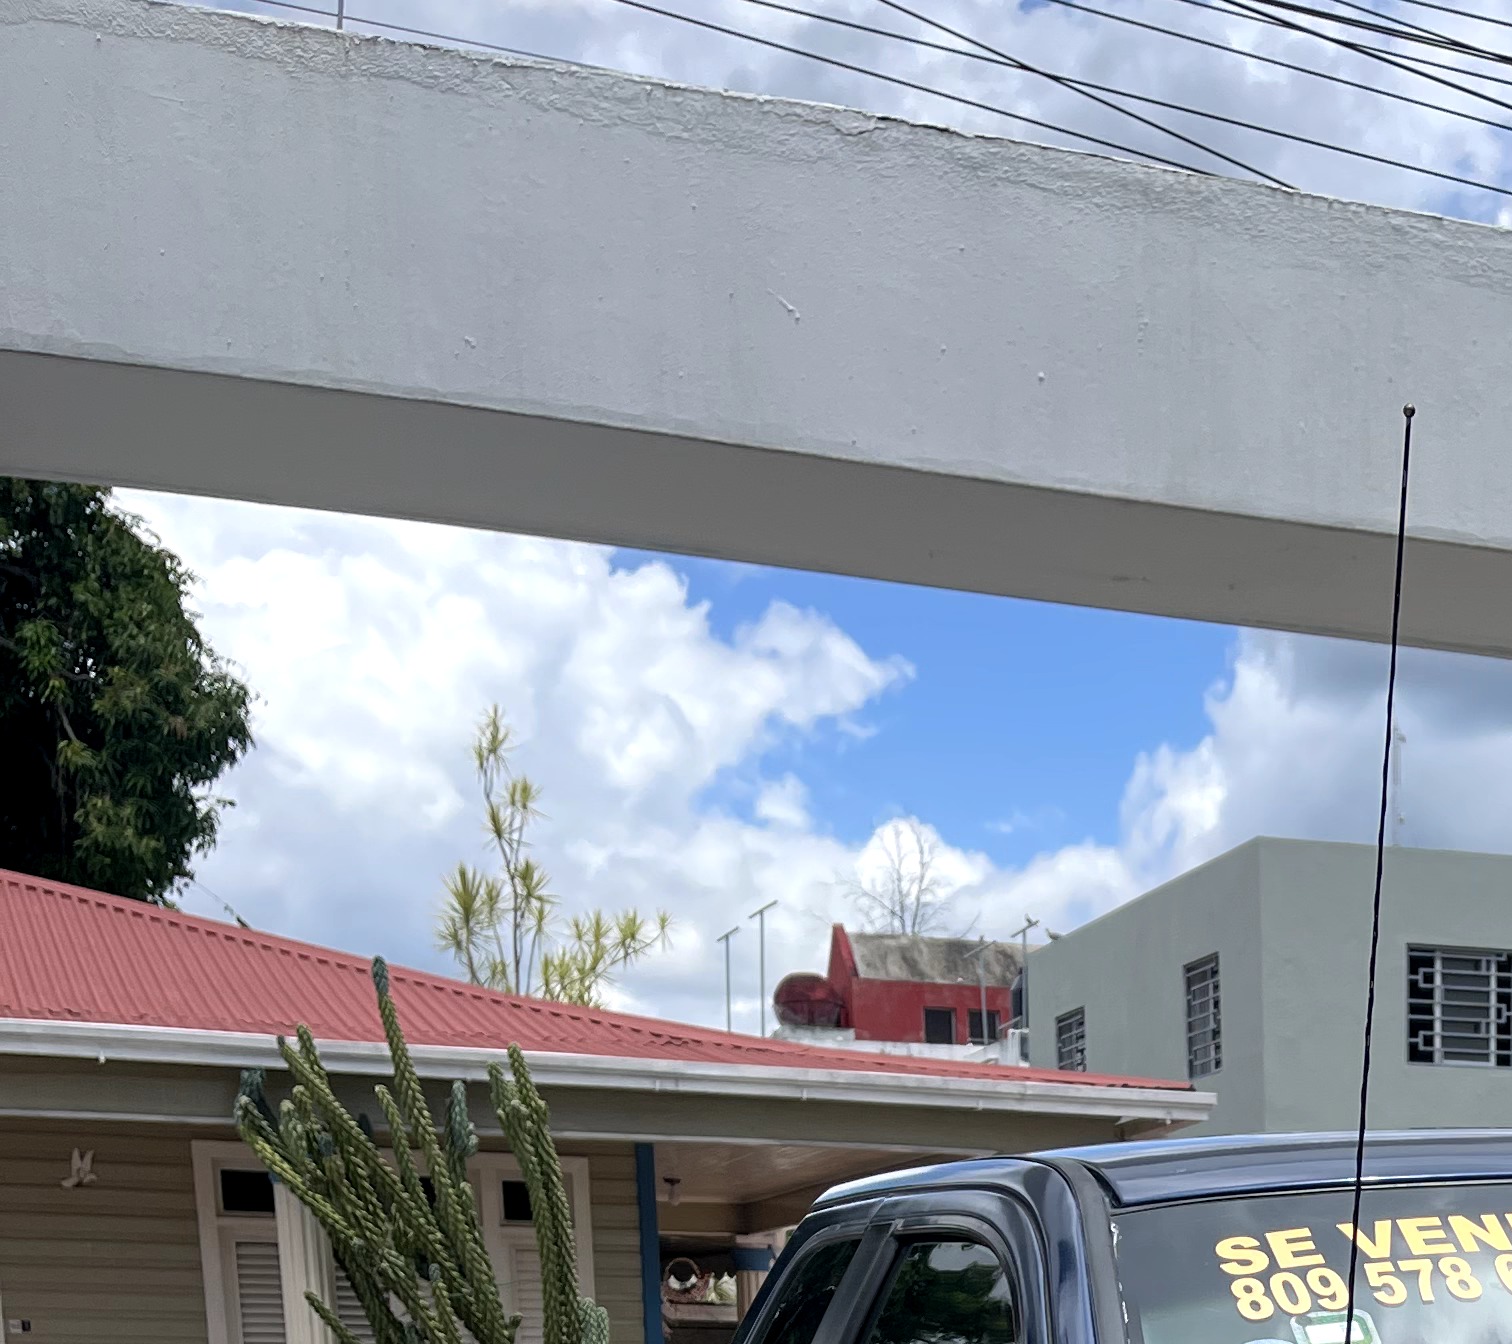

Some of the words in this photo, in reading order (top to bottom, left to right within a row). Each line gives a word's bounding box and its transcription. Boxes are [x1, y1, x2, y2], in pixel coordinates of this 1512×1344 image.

[1215, 1227, 1325, 1275] SE
[1229, 1267, 1350, 1321] 809
[1363, 1257, 1484, 1306] 578
